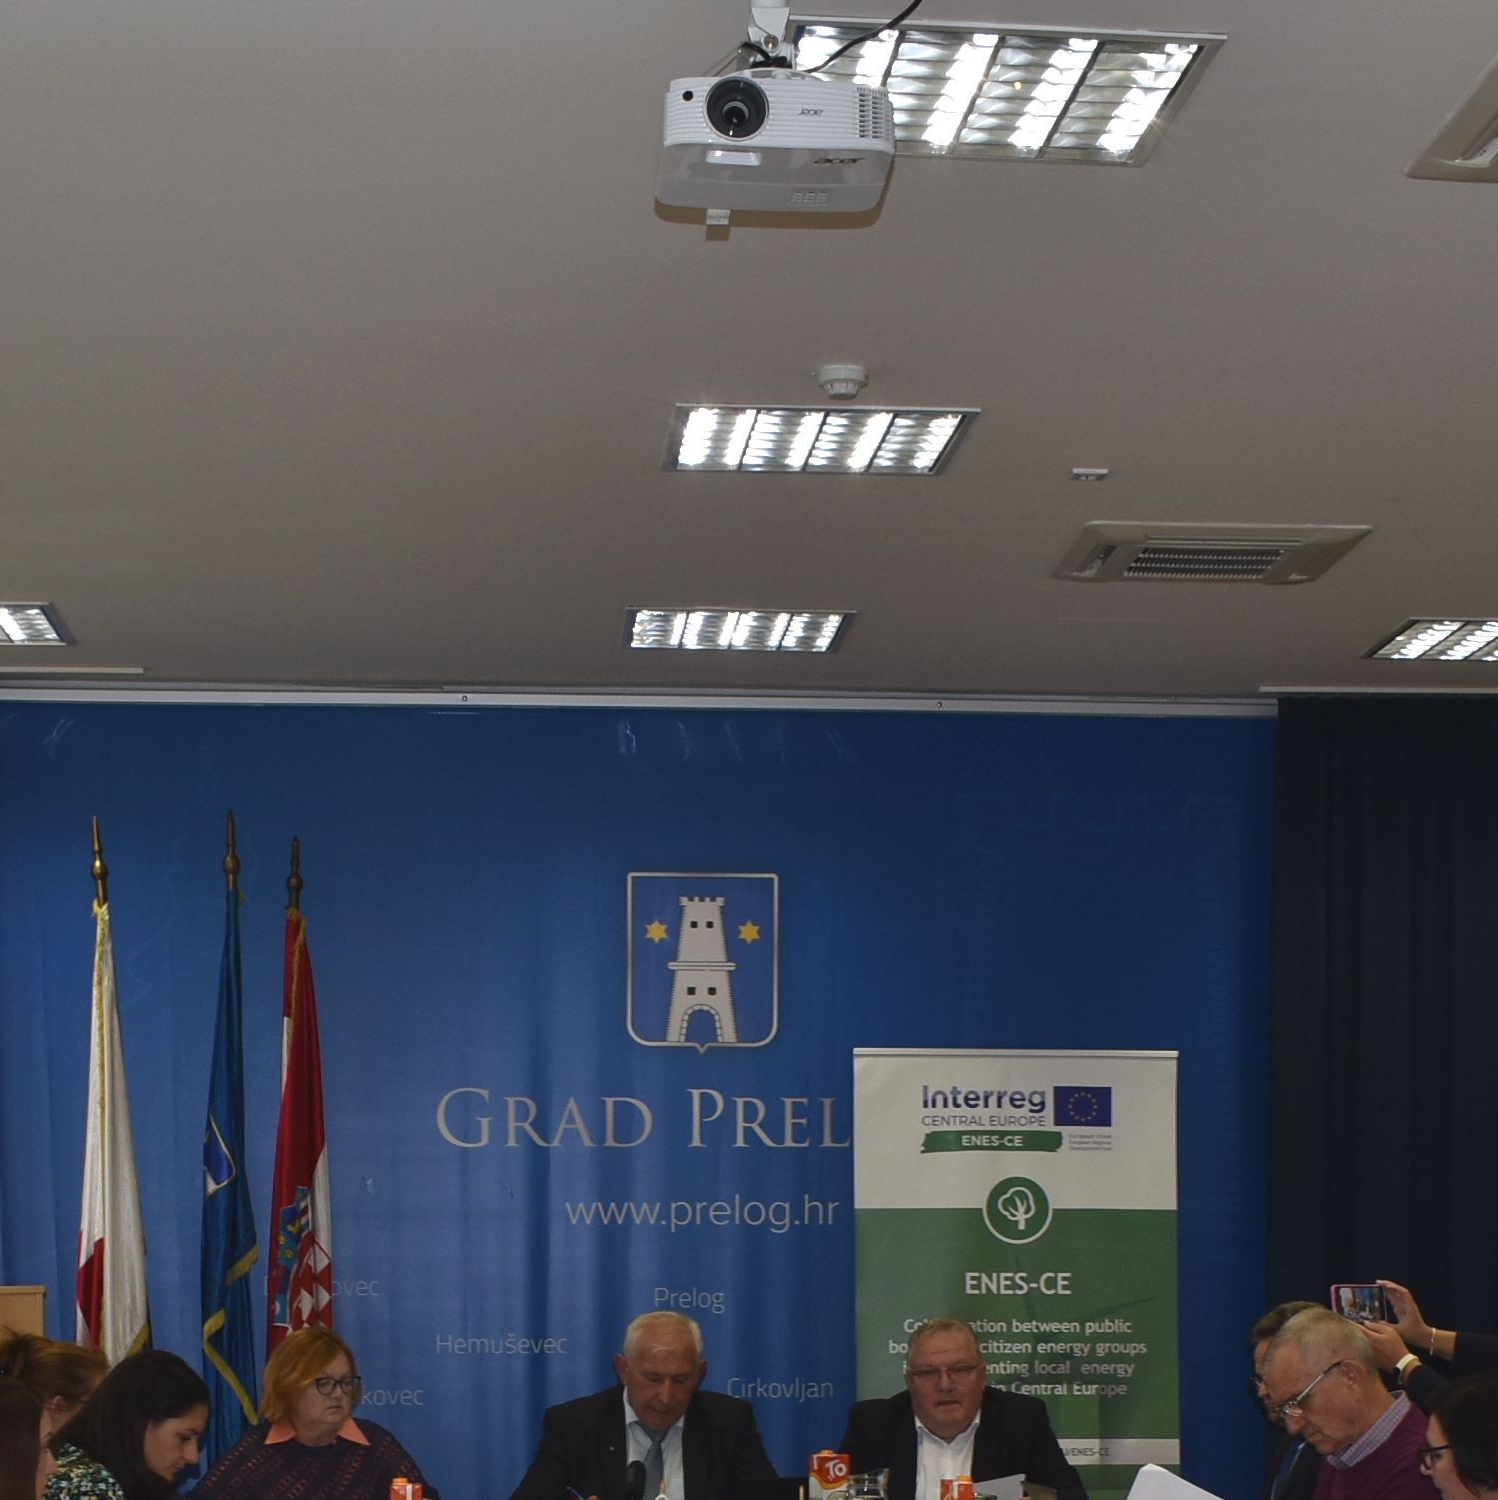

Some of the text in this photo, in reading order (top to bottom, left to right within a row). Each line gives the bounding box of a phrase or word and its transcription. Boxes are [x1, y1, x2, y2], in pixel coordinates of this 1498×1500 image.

[921, 1085, 1046, 1114] Interreg
[436, 1087, 851, 1148] GRAD PREL
[921, 1115, 1046, 1127] CENTRAL EUROPE
[961, 1135, 1023, 1147] ENES-CE
[565, 1194, 840, 1233] www.prelog.hr
[964, 1272, 1073, 1295] ENES-CE
[654, 1287, 726, 1314] Prelog
[1012, 1318, 1081, 1333] between
[1085, 1318, 1132, 1336] public
[435, 1333, 568, 1355] Hemuševec
[979, 1340, 1032, 1354] citizen
[1036, 1342, 1091, 1357] energy
[1096, 1342, 1147, 1357] groups
[1034, 1361, 1070, 1375] local
[1081, 1363, 1135, 1378] energy
[726, 1377, 834, 1403] Cirkovljan
[1011, 1382, 1068, 1396] Central
[1072, 1382, 1128, 1398] Europe
